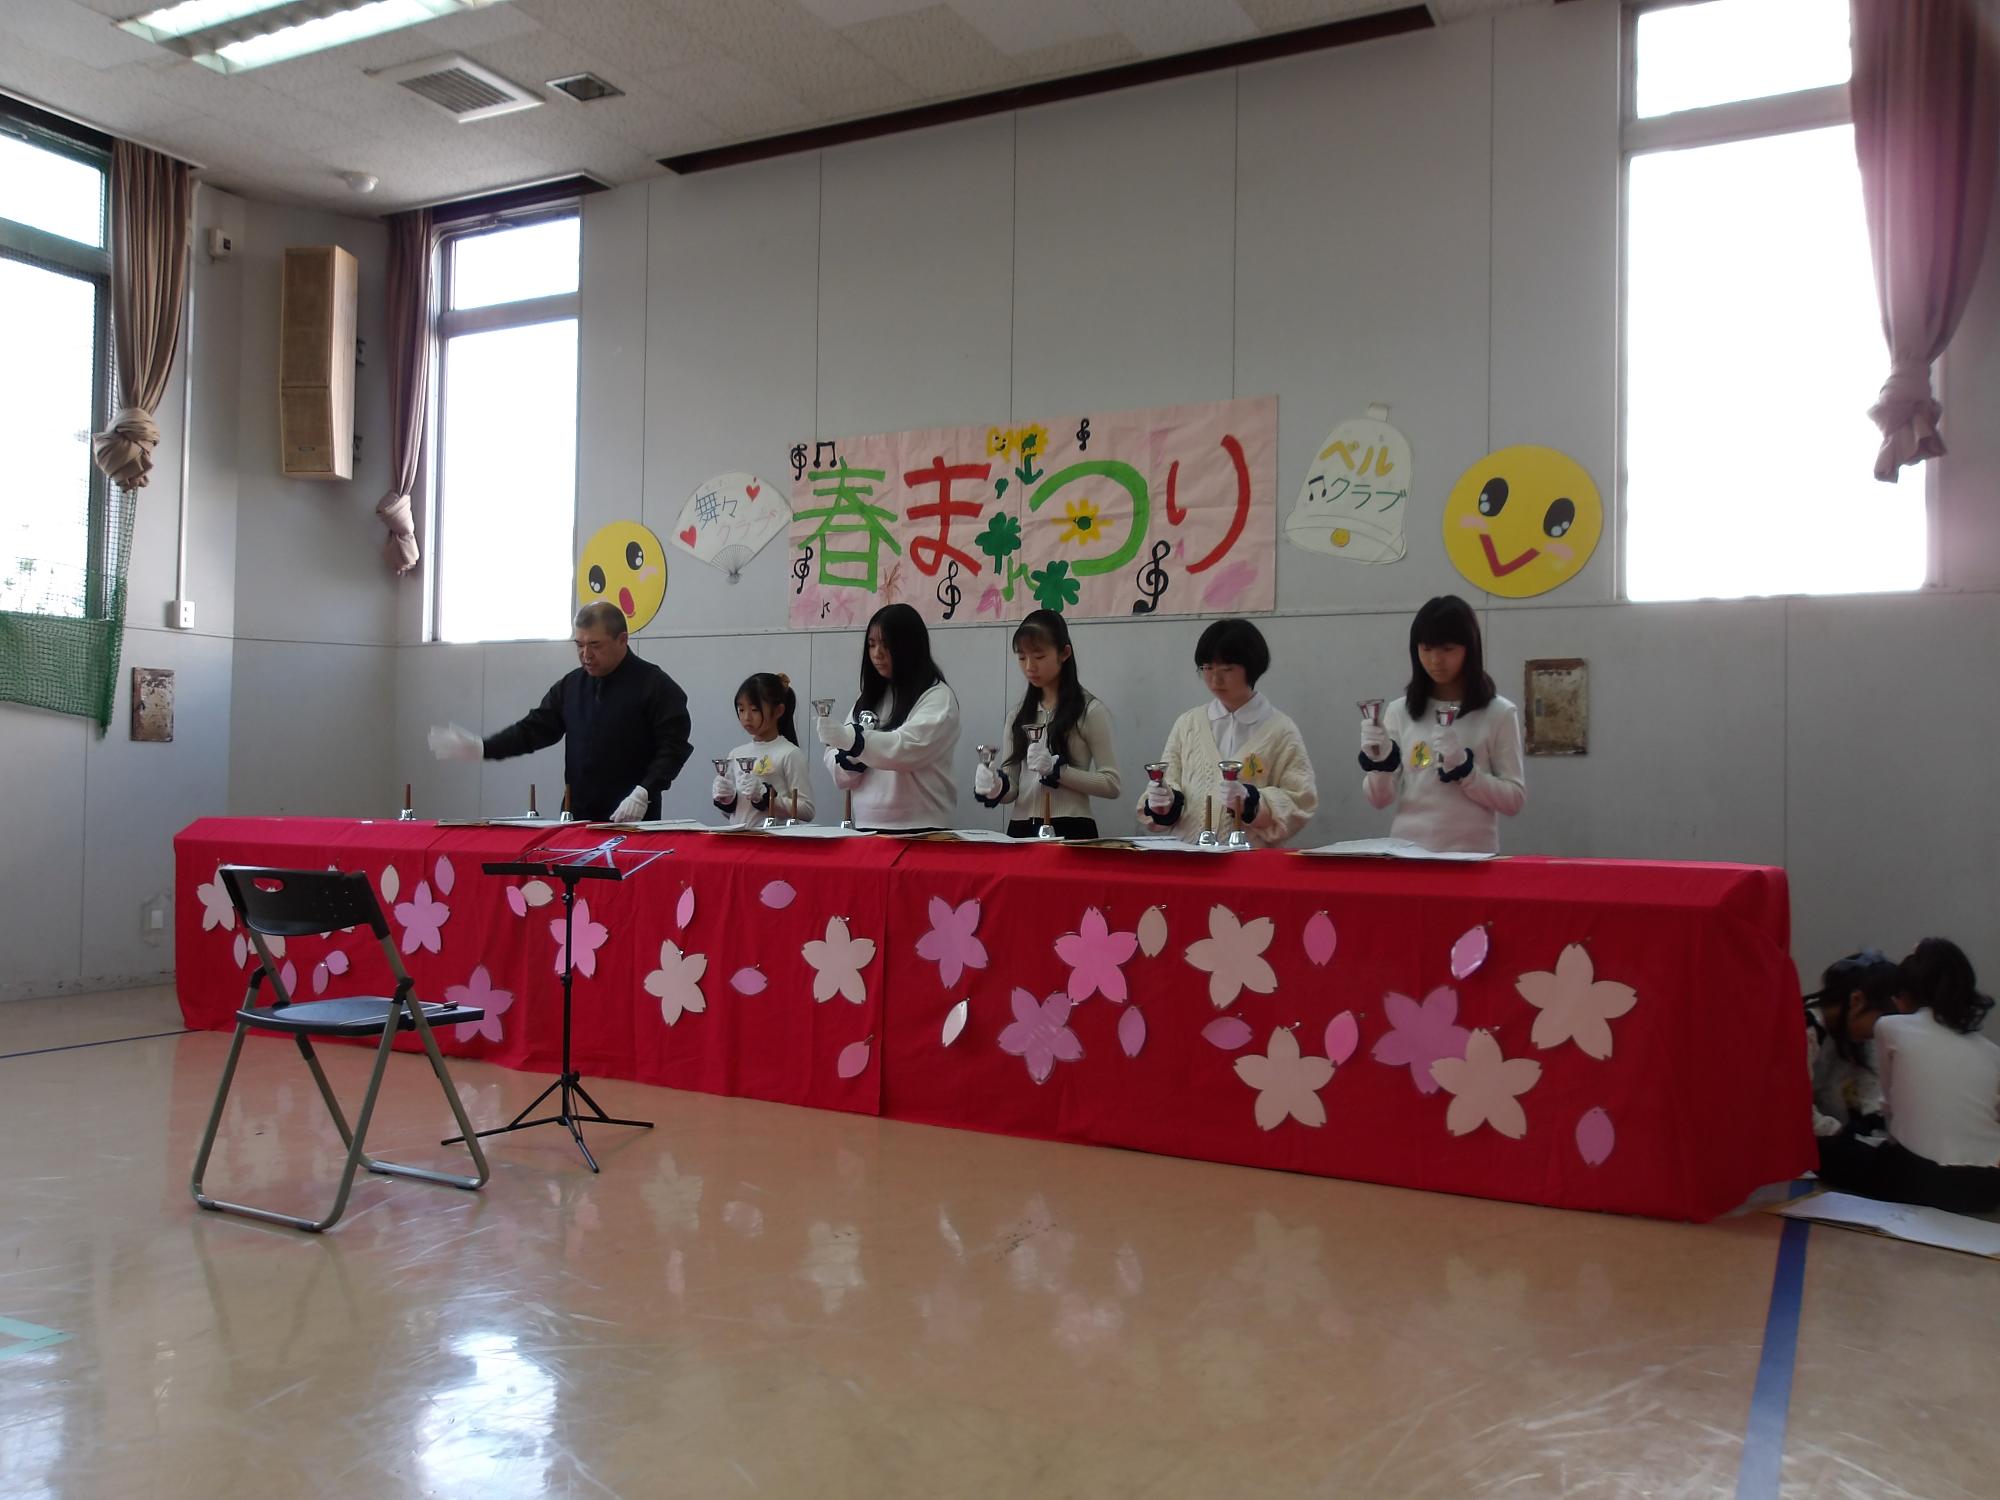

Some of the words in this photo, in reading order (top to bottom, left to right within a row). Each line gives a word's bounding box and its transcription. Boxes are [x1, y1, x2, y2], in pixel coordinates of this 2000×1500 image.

[1319, 440, 1395, 477] ベル
[793, 434, 1251, 593] 春まつり
[1326, 477, 1407, 513] クラブ
